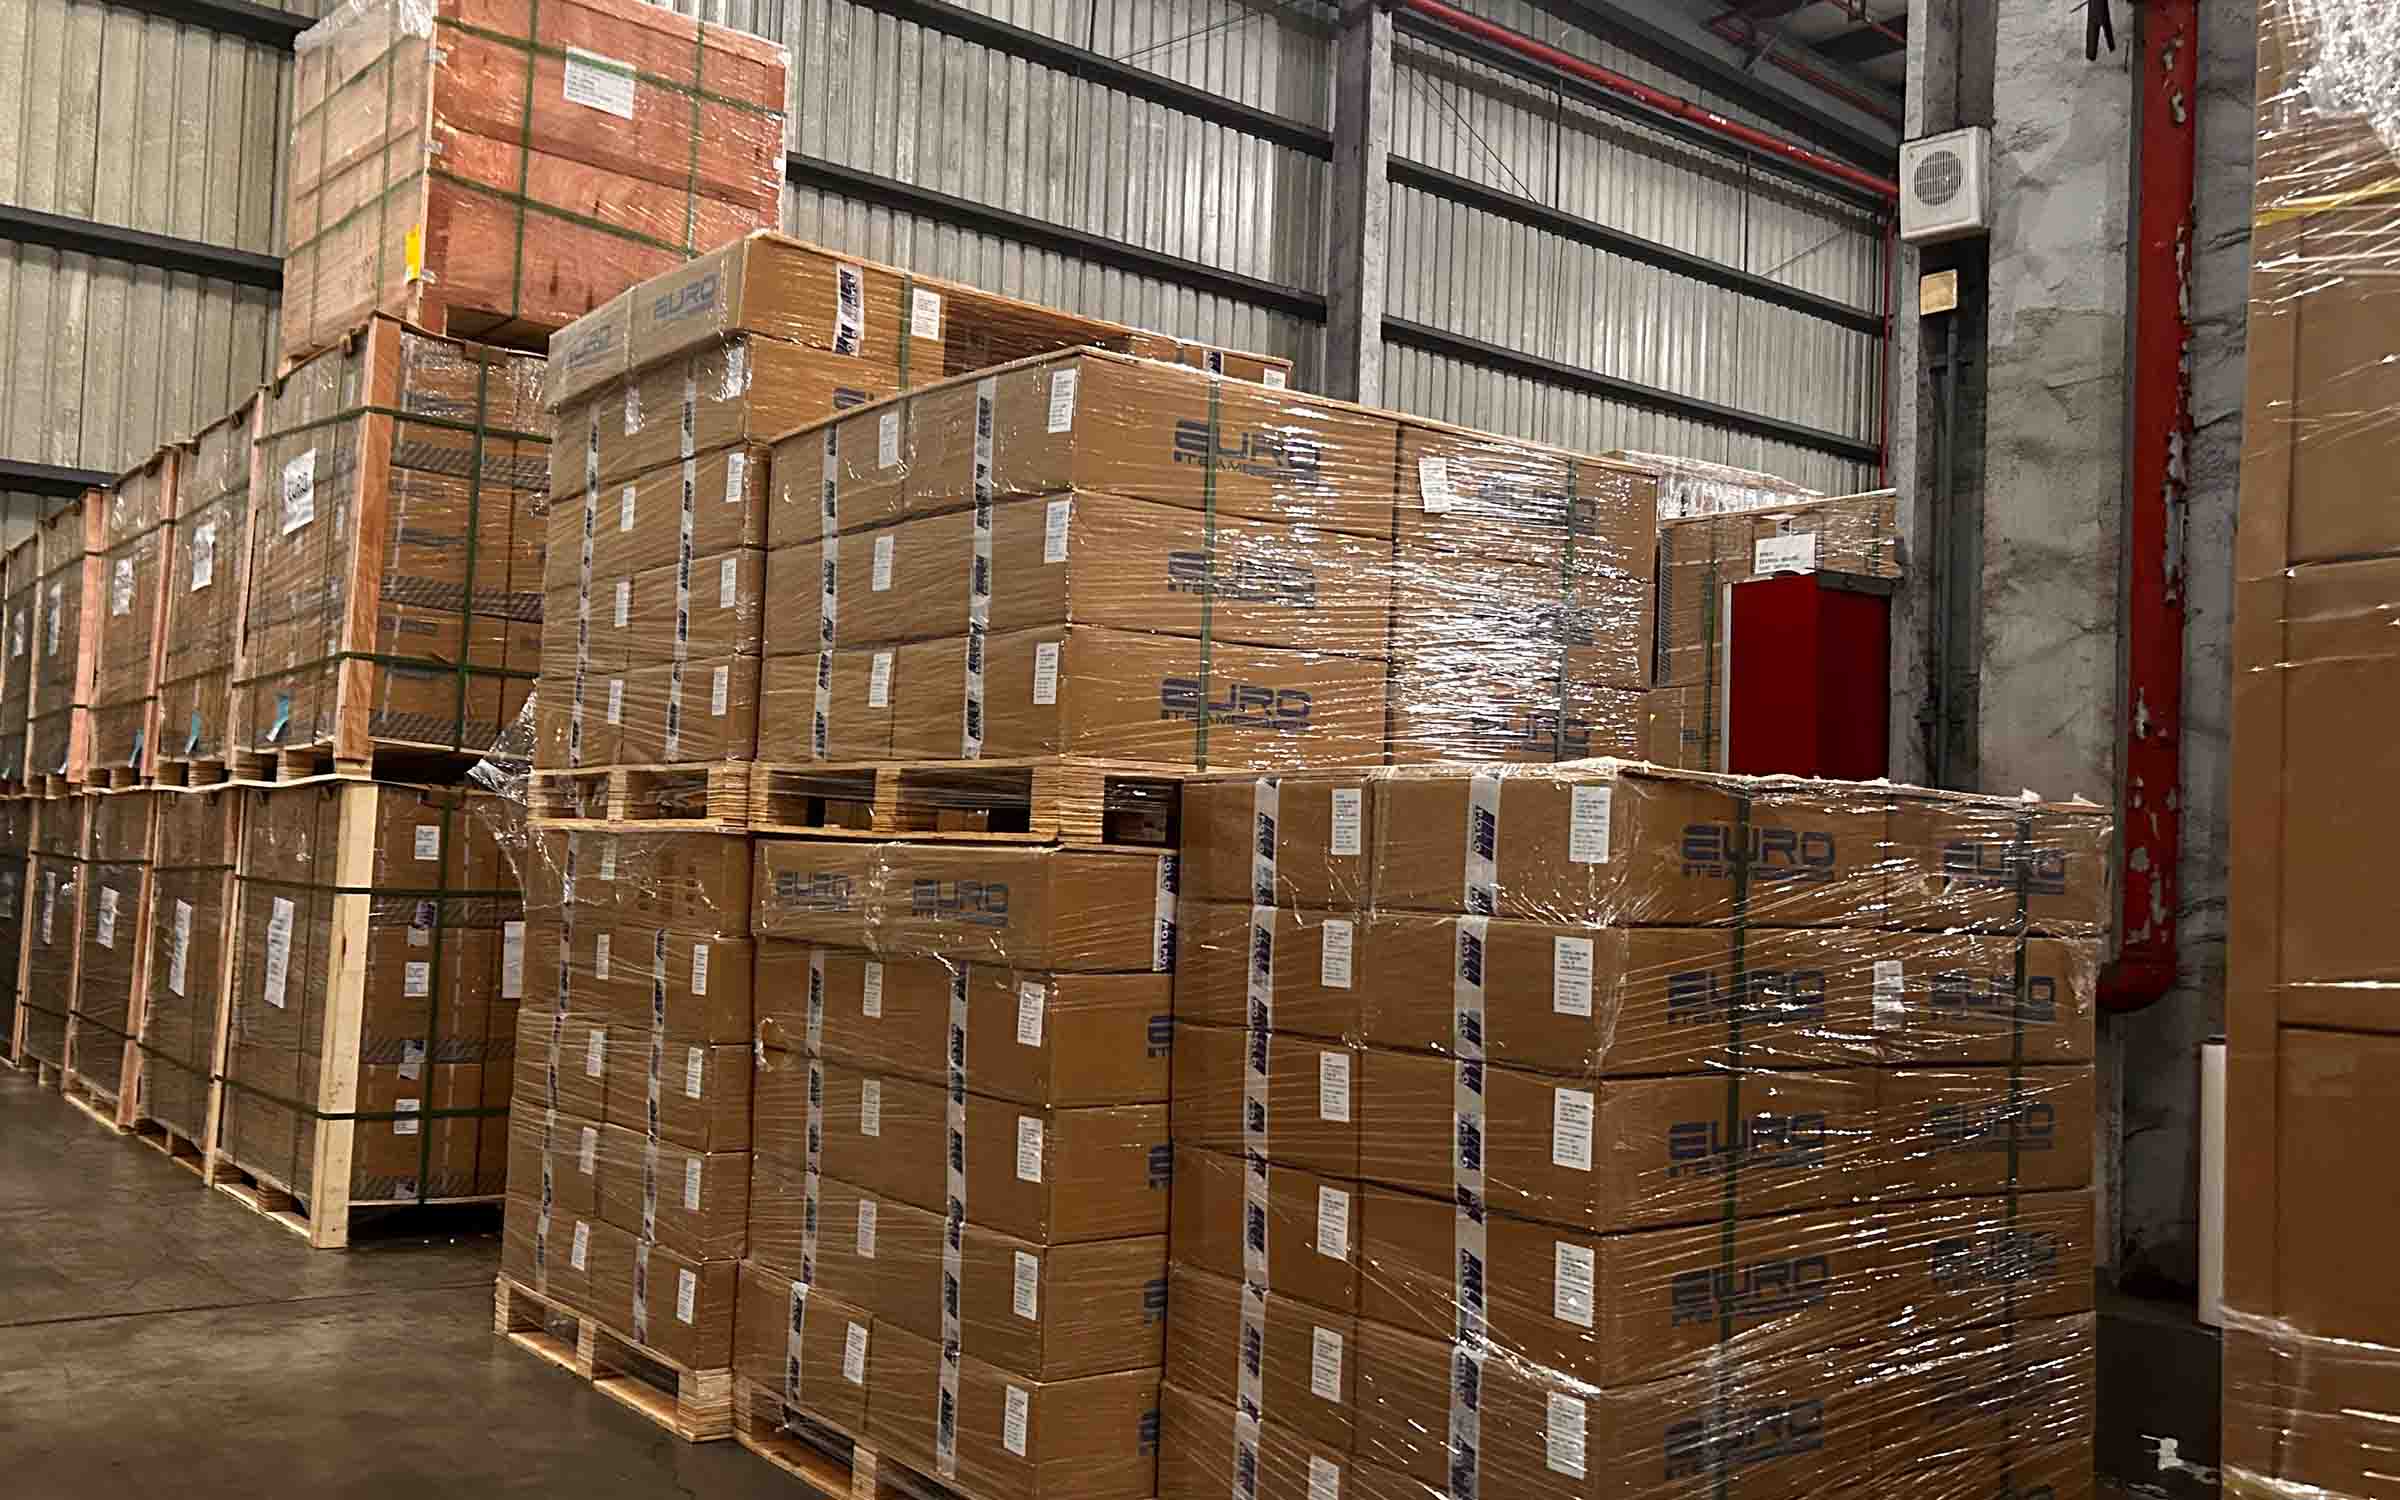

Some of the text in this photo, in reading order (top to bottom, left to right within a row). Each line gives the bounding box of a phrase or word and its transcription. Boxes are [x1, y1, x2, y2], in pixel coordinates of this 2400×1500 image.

[1162, 678, 1312, 718] EURO
[1681, 825, 1835, 866] EURO
[912, 880, 1009, 913] EURO
[1669, 971, 1825, 1008] EURO
[1670, 1112, 1825, 1158] EURO
